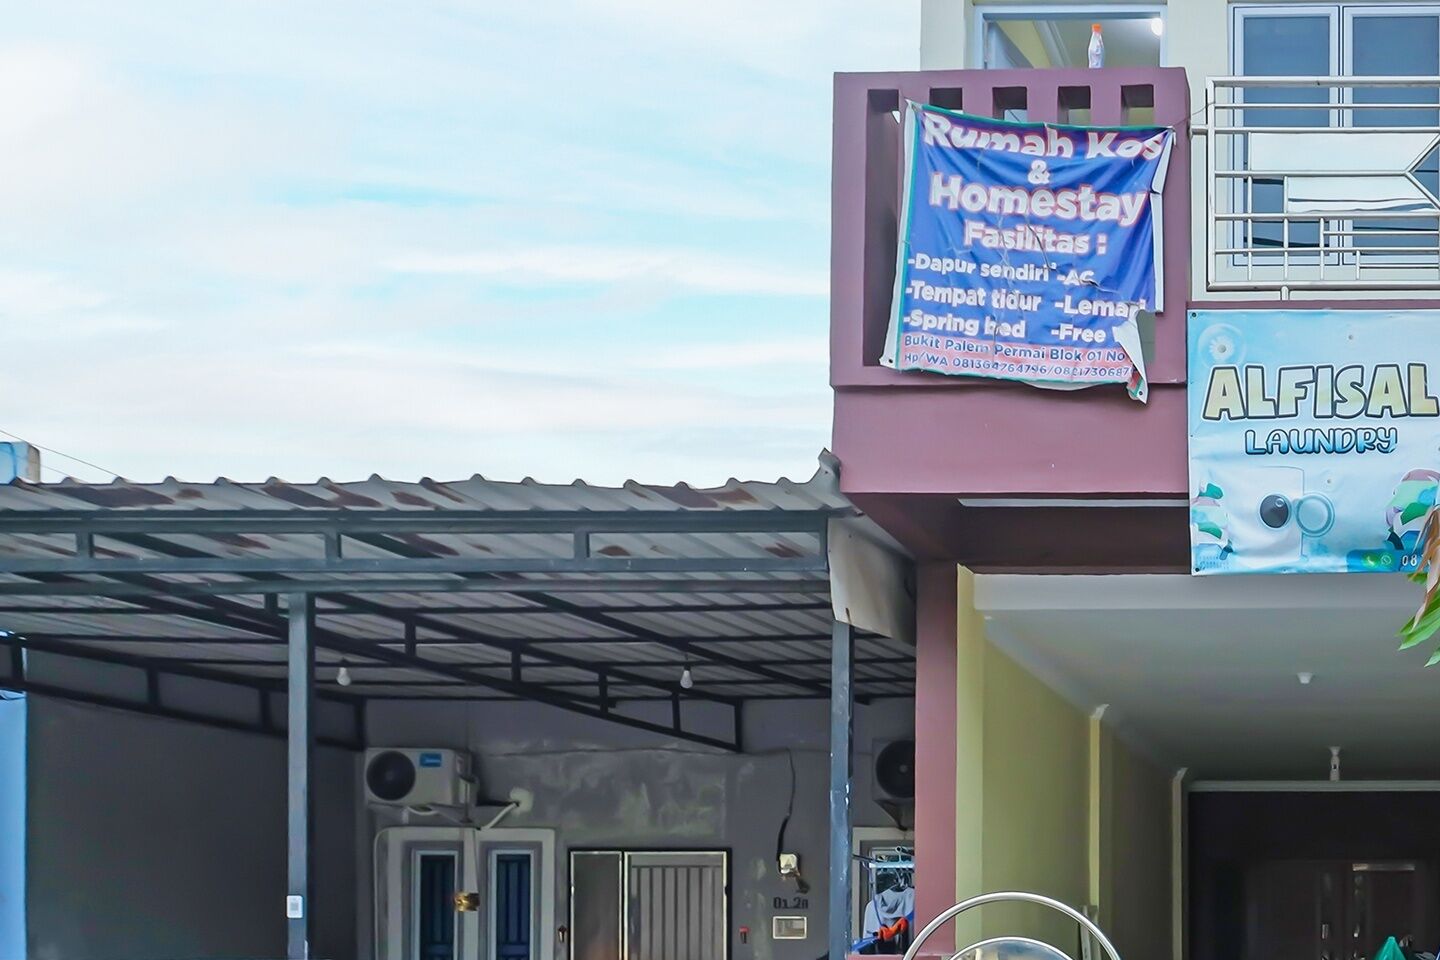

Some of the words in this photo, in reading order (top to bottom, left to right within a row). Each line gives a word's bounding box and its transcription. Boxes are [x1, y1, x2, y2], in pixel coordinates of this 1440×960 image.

[923, 112, 1074, 159] Rumah
[1027, 159, 1051, 184] &
[928, 172, 1149, 227] Homestay
[964, 220, 1090, 255] Fasilitas
[908, 252, 977, 275] -Dapur
[980, 263, 1049, 282] sendiri
[905, 280, 987, 308] -Tempat
[991, 289, 1042, 312] tidur
[903, 309, 980, 337] -Spring
[984, 315, 1026, 339] bed
[1051, 323, 1107, 344] -Free
[904, 334, 941, 349] Bukit
[945, 339, 989, 353] Palem
[993, 344, 1046, 360] Permai
[1050, 348, 1082, 361] Blok
[1087, 351, 1101, 361] 01
[1106, 351, 1126, 361] No
[904, 352, 949, 366] Hp/WA
[1202, 362, 1440, 421] ALFISAL
[1245, 426, 1398, 456] LAUNDRY
